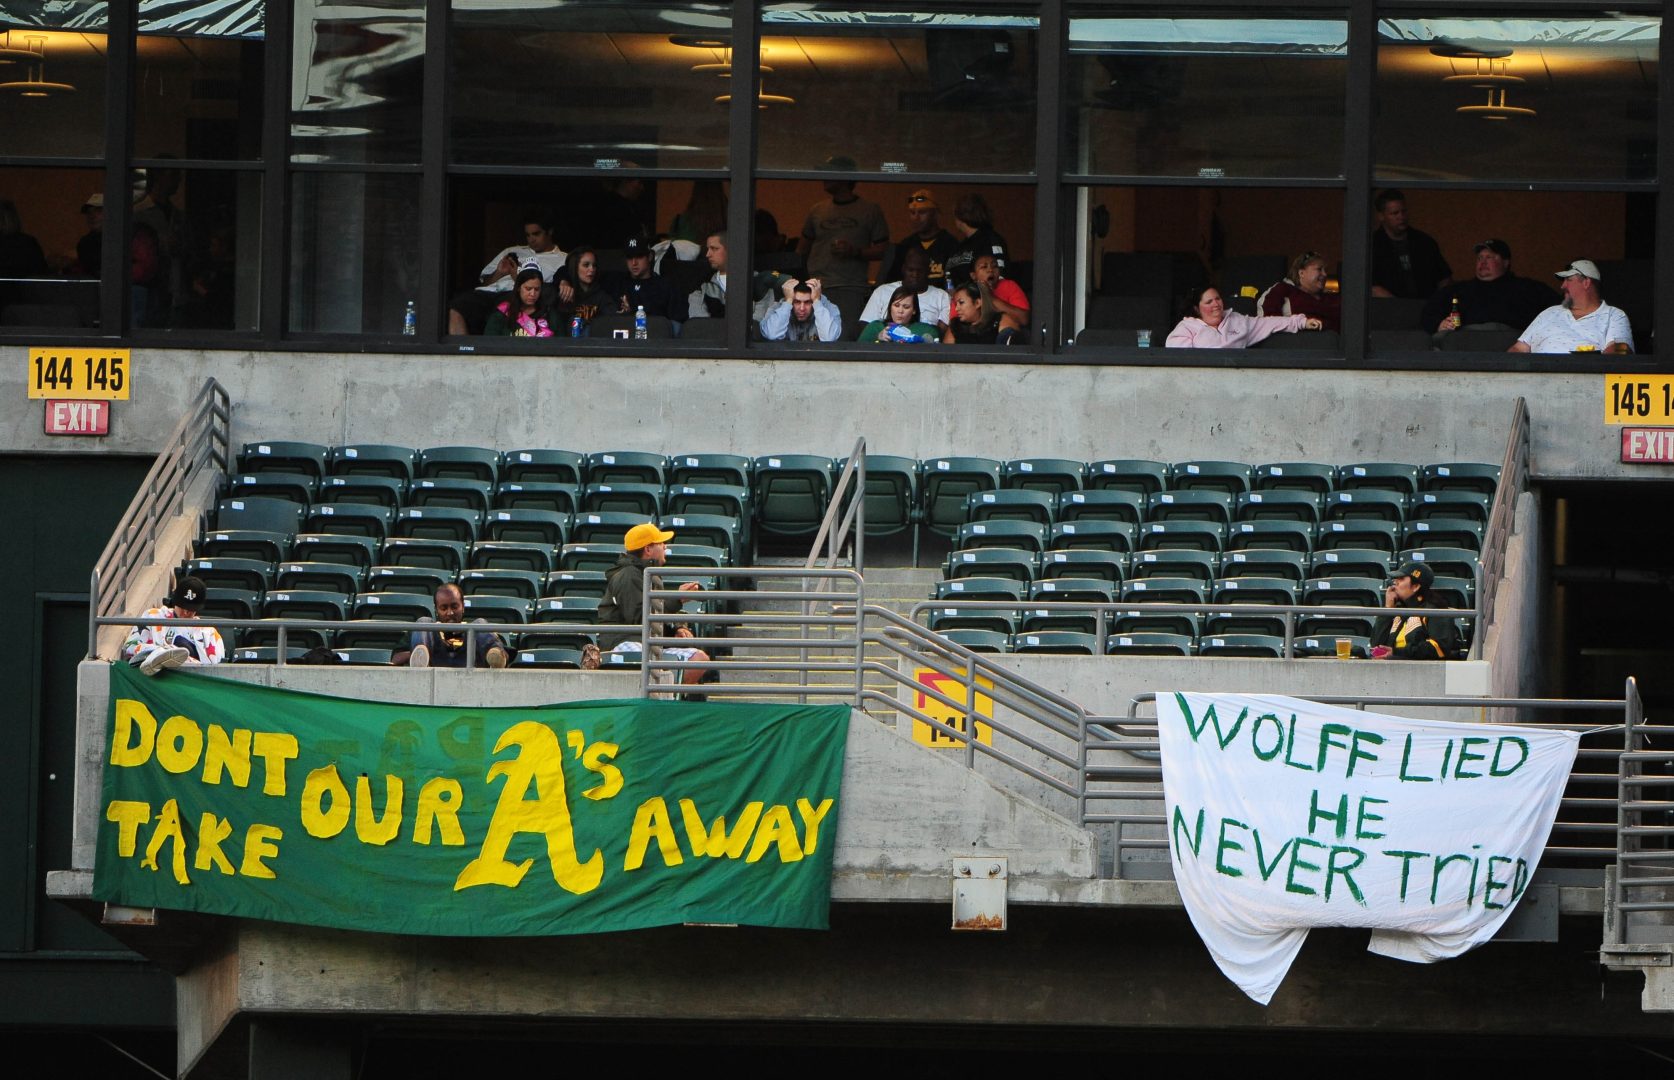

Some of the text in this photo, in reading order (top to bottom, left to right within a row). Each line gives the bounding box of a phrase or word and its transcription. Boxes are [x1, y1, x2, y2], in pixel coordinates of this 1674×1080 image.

[35, 356, 124, 392] 144 145
[1611, 382, 1674, 417] 145 1
[53, 402, 101, 432] EXIT
[1629, 430, 1674, 460] EXIT
[110, 698, 299, 796] DONT
[1173, 691, 1530, 784] WOLFF LIED
[106, 798, 284, 886] TAKE
[301, 764, 466, 846] OUR
[623, 796, 834, 872] AWAY
[1307, 788, 1390, 841] HE
[1172, 804, 1368, 907] NEVER
